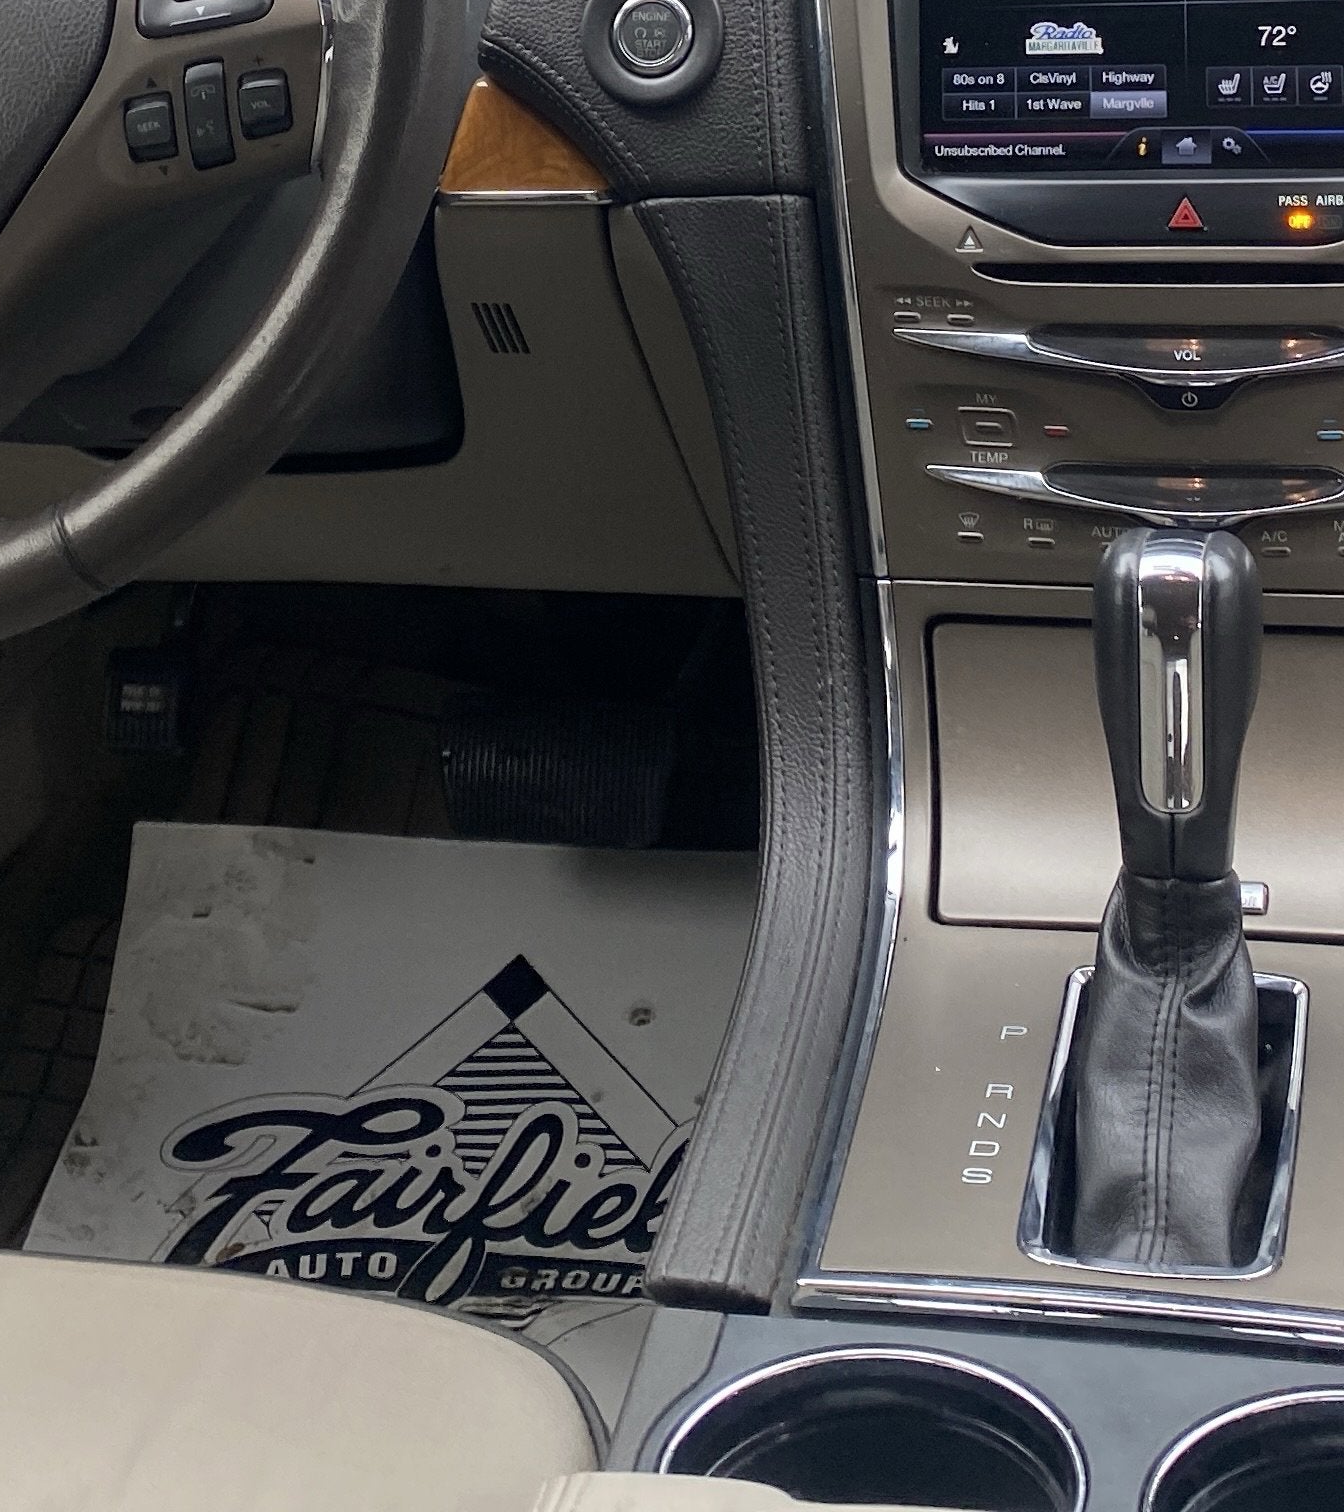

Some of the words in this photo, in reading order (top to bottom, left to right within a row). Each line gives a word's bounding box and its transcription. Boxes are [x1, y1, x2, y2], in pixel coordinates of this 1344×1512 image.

[632, 11, 671, 22] ENGINE
[1033, 23, 1094, 40] Radio
[1258, 25, 1297, 47] 72°
[953, 74, 975, 85] 80s
[978, 75, 994, 85] on
[997, 73, 1005, 84] 8
[1030, 72, 1077, 86] ClsVinyl
[1102, 71, 1155, 86] Highway
[963, 100, 985, 111] Hits
[1027, 99, 1044, 110] 1st
[1046, 98, 1082, 110] Wave
[934, 144, 1013, 156] Unsubscribed
[1278, 195, 1308, 207] PASS
[1288, 214, 1313, 229] OFF
[916, 296, 951, 308] SEEK
[1174, 350, 1201, 361] VOL
[976, 393, 997, 403] MY
[969, 451, 1008, 464] TEMP
[1262, 530, 1288, 542] A/C
[1000, 1026, 1028, 1040] P
[977, 1112, 1007, 1129] N
[968, 1140, 1000, 1157] D
[961, 1167, 993, 1184] S
[164, 1097, 689, 1306] Fairfiel
[266, 1251, 397, 1279] AUTO
